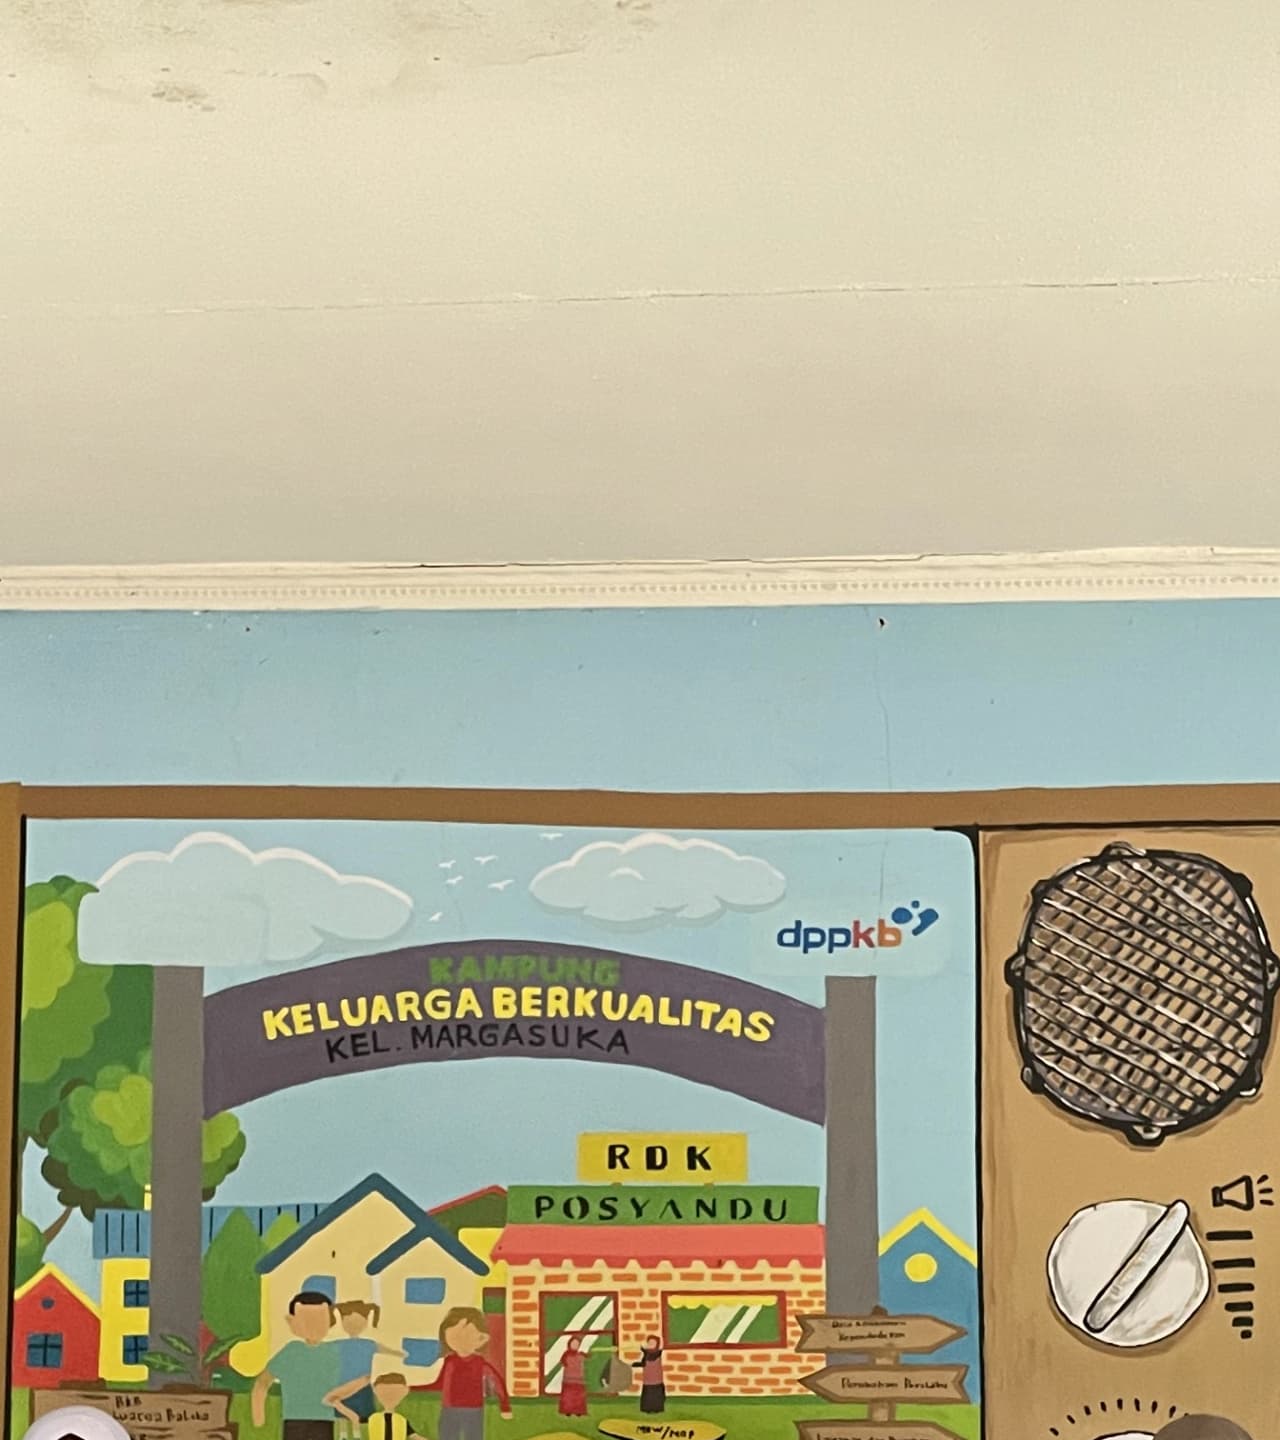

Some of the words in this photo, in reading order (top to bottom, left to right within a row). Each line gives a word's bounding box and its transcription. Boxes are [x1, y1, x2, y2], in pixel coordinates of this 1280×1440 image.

[776, 917, 904, 955] dppkb
[429, 955, 620, 986] KAMPUNG
[263, 988, 482, 1041] KELUARGA
[492, 986, 775, 1043] BERKUALITAS
[326, 1029, 401, 1063] KEL.
[411, 1021, 631, 1055] MARGASUKA
[534, 1194, 790, 1223] POSYANDU
